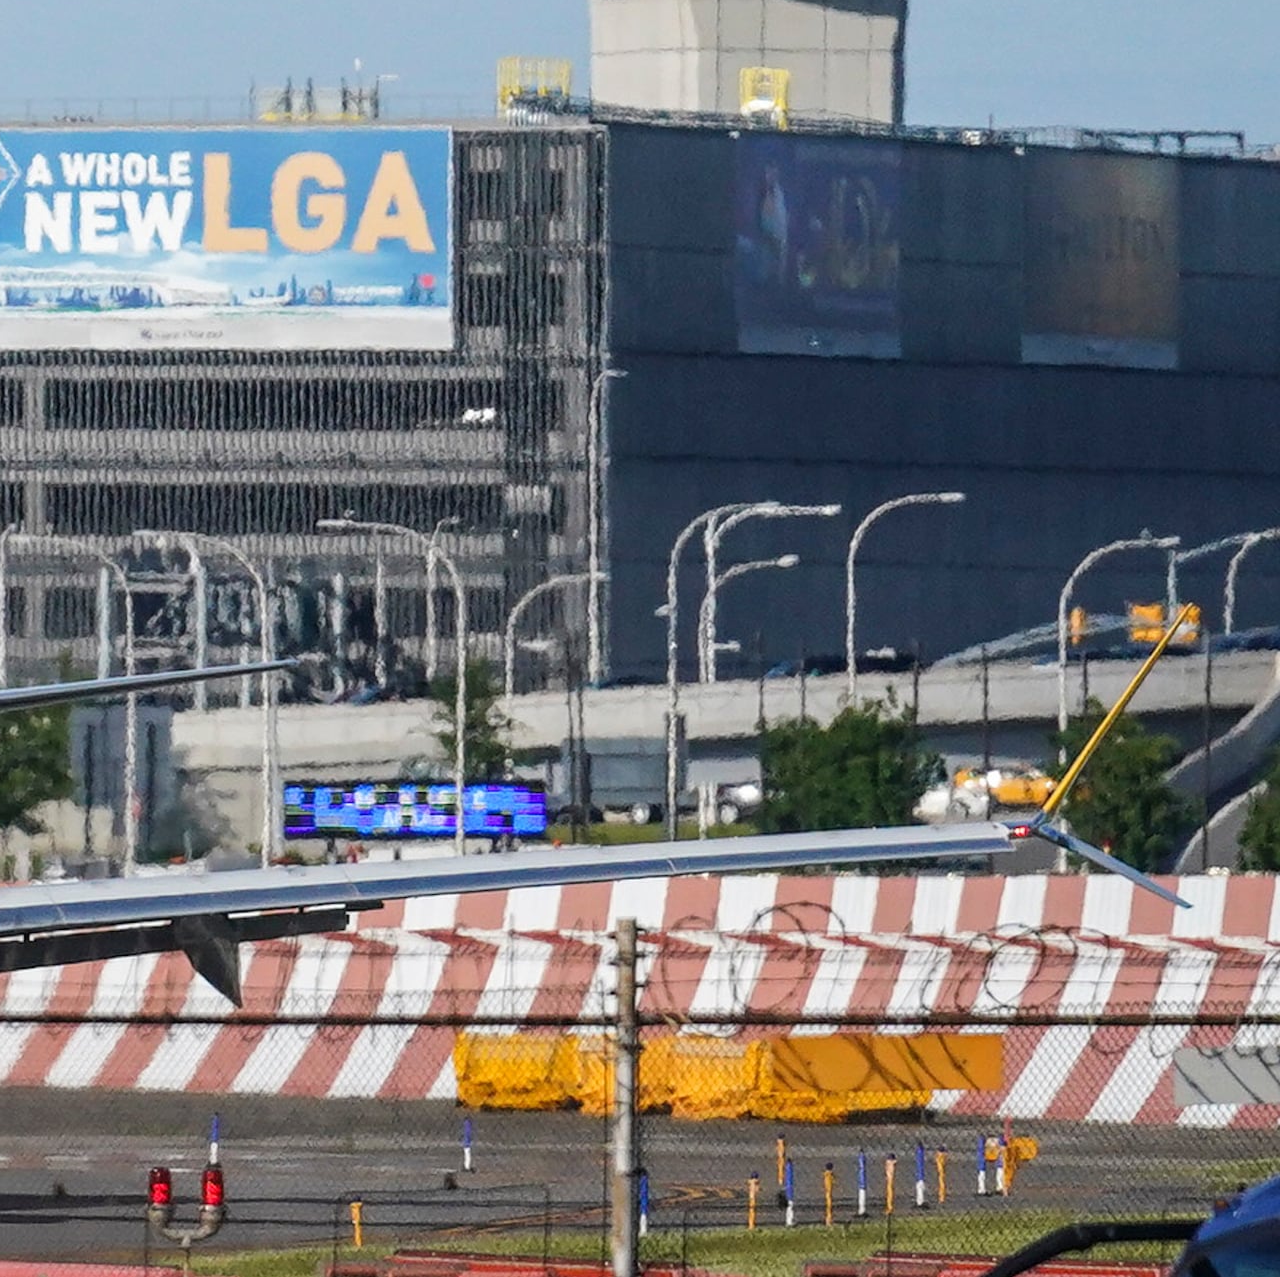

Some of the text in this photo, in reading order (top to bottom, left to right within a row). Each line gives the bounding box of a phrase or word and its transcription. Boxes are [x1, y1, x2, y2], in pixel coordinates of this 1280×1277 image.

[24, 151, 436, 254] NEW LGA
[26, 151, 193, 187] A WHOLE
